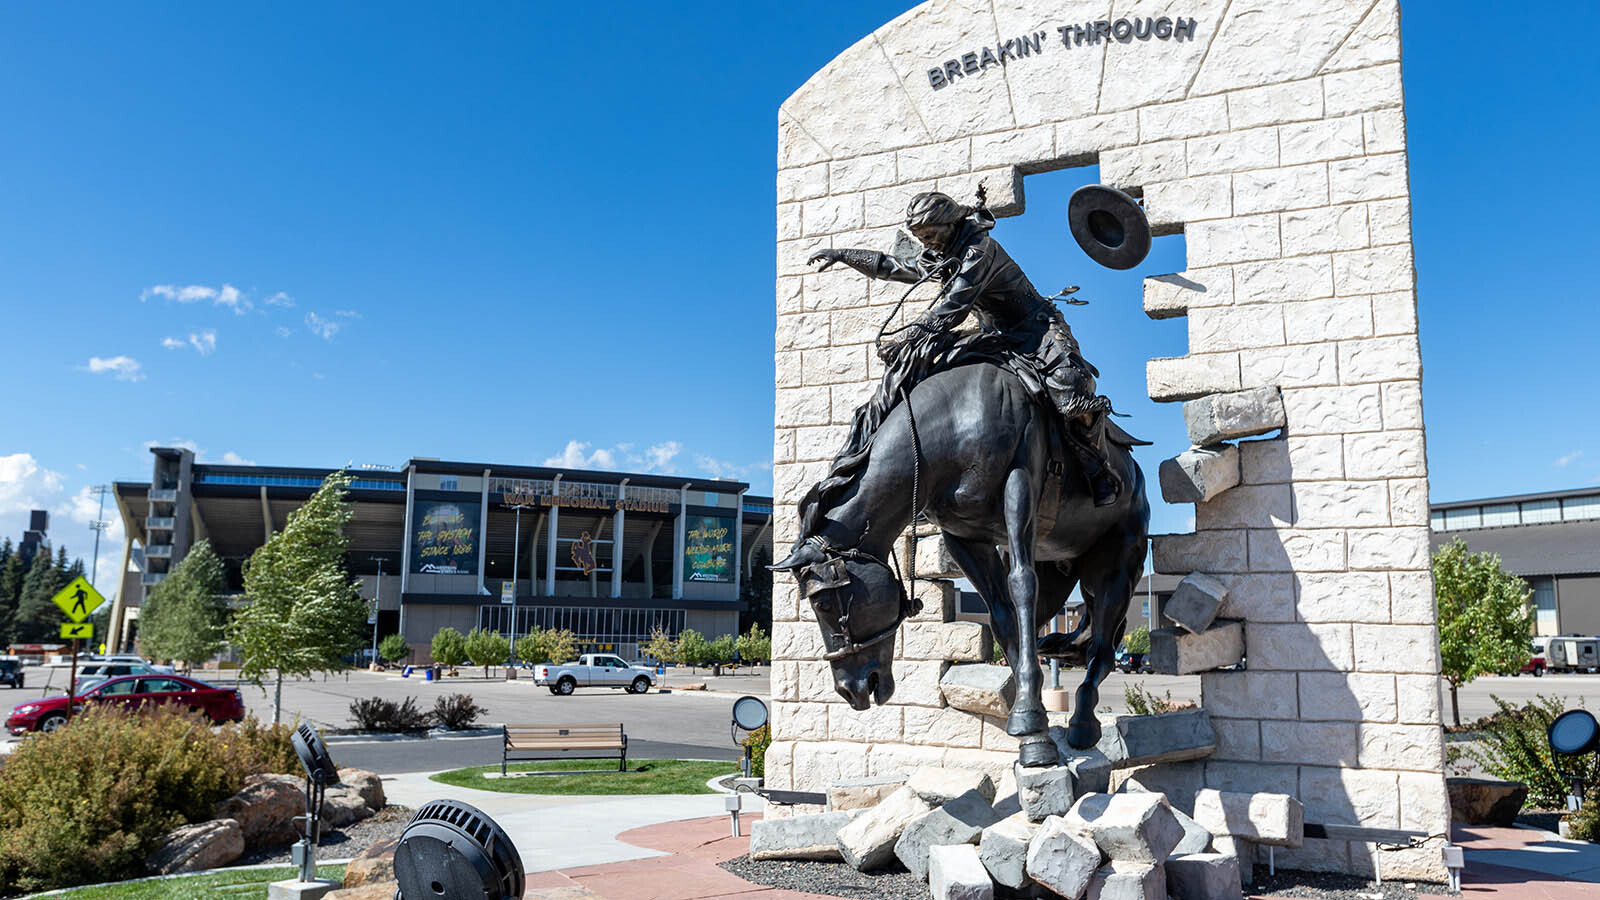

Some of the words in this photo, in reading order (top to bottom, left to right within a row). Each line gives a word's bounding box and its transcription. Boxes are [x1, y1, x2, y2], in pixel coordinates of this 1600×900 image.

[927, 30, 1046, 91] BREAKIN'
[1057, 17, 1198, 50] THROUGH
[504, 492, 535, 506] WAR
[540, 495, 611, 510] MEMORIAL
[615, 500, 670, 513] STADIUM
